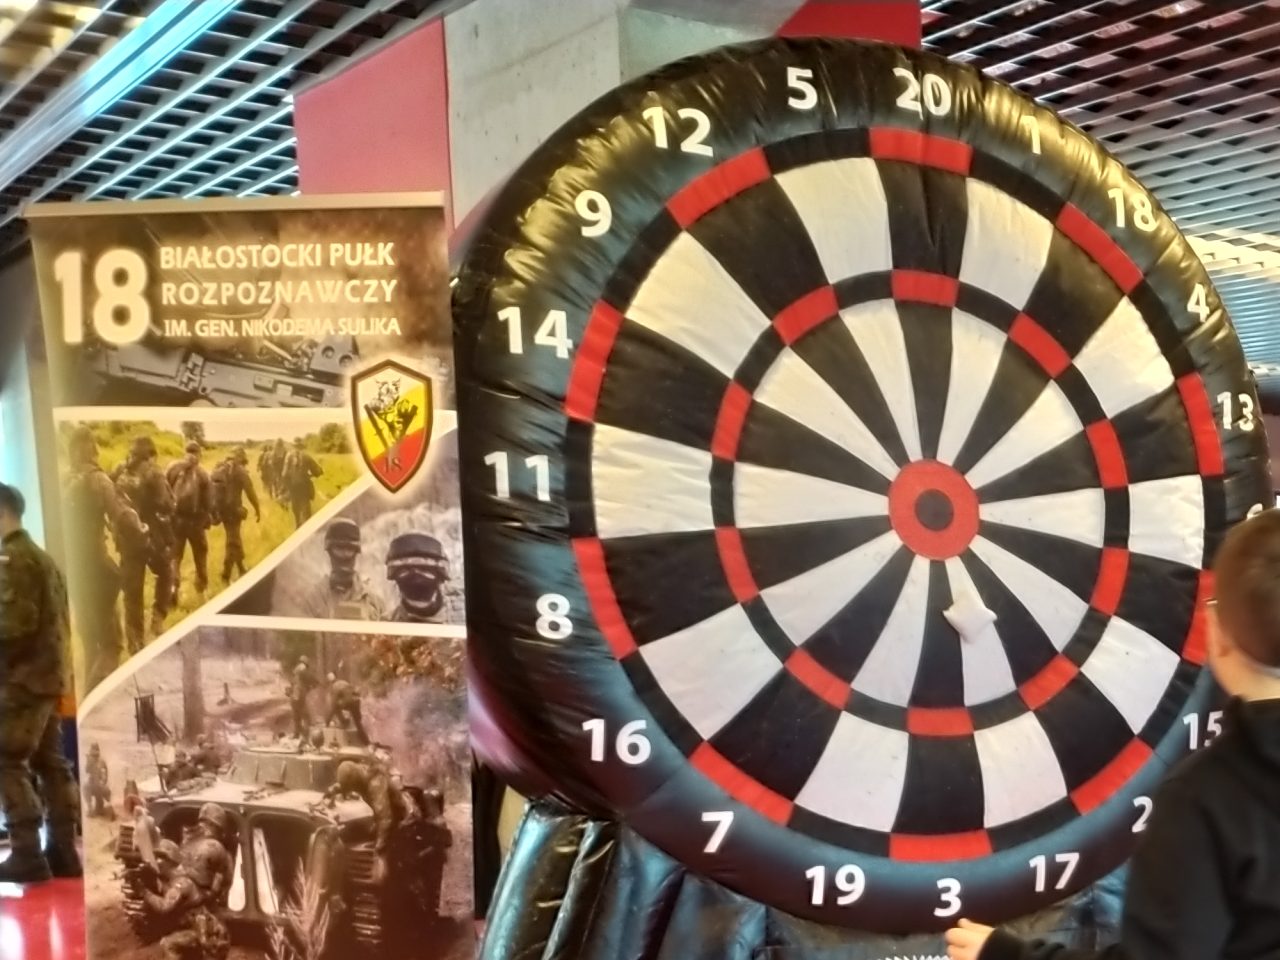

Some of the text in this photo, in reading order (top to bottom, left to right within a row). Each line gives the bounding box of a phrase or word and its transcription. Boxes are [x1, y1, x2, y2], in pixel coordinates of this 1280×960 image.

[787, 67, 818, 110] 5
[892, 67, 952, 118] 20
[642, 106, 714, 157] 12
[1022, 116, 1042, 155] 1
[574, 190, 613, 237] 9
[1108, 188, 1158, 231] 18
[160, 242, 396, 270] BIAŁOSTOCKI PUŁK
[53, 248, 151, 344] 18
[161, 279, 398, 305] ROZPOZNAWCZY
[1186, 284, 1211, 323] 4
[164, 317, 401, 337] IM. GEN. NIKODEMA SULIKA
[497, 306, 574, 359] 14
[1216, 391, 1254, 432] 13
[484, 451, 551, 501] 11
[535, 593, 574, 639] 8
[582, 718, 652, 764] 16
[1182, 710, 1223, 751] 15
[701, 811, 735, 854] 7
[1131, 795, 1153, 833] 2
[805, 864, 867, 907] 19
[1029, 852, 1081, 893] 17
[933, 878, 962, 917] 3
